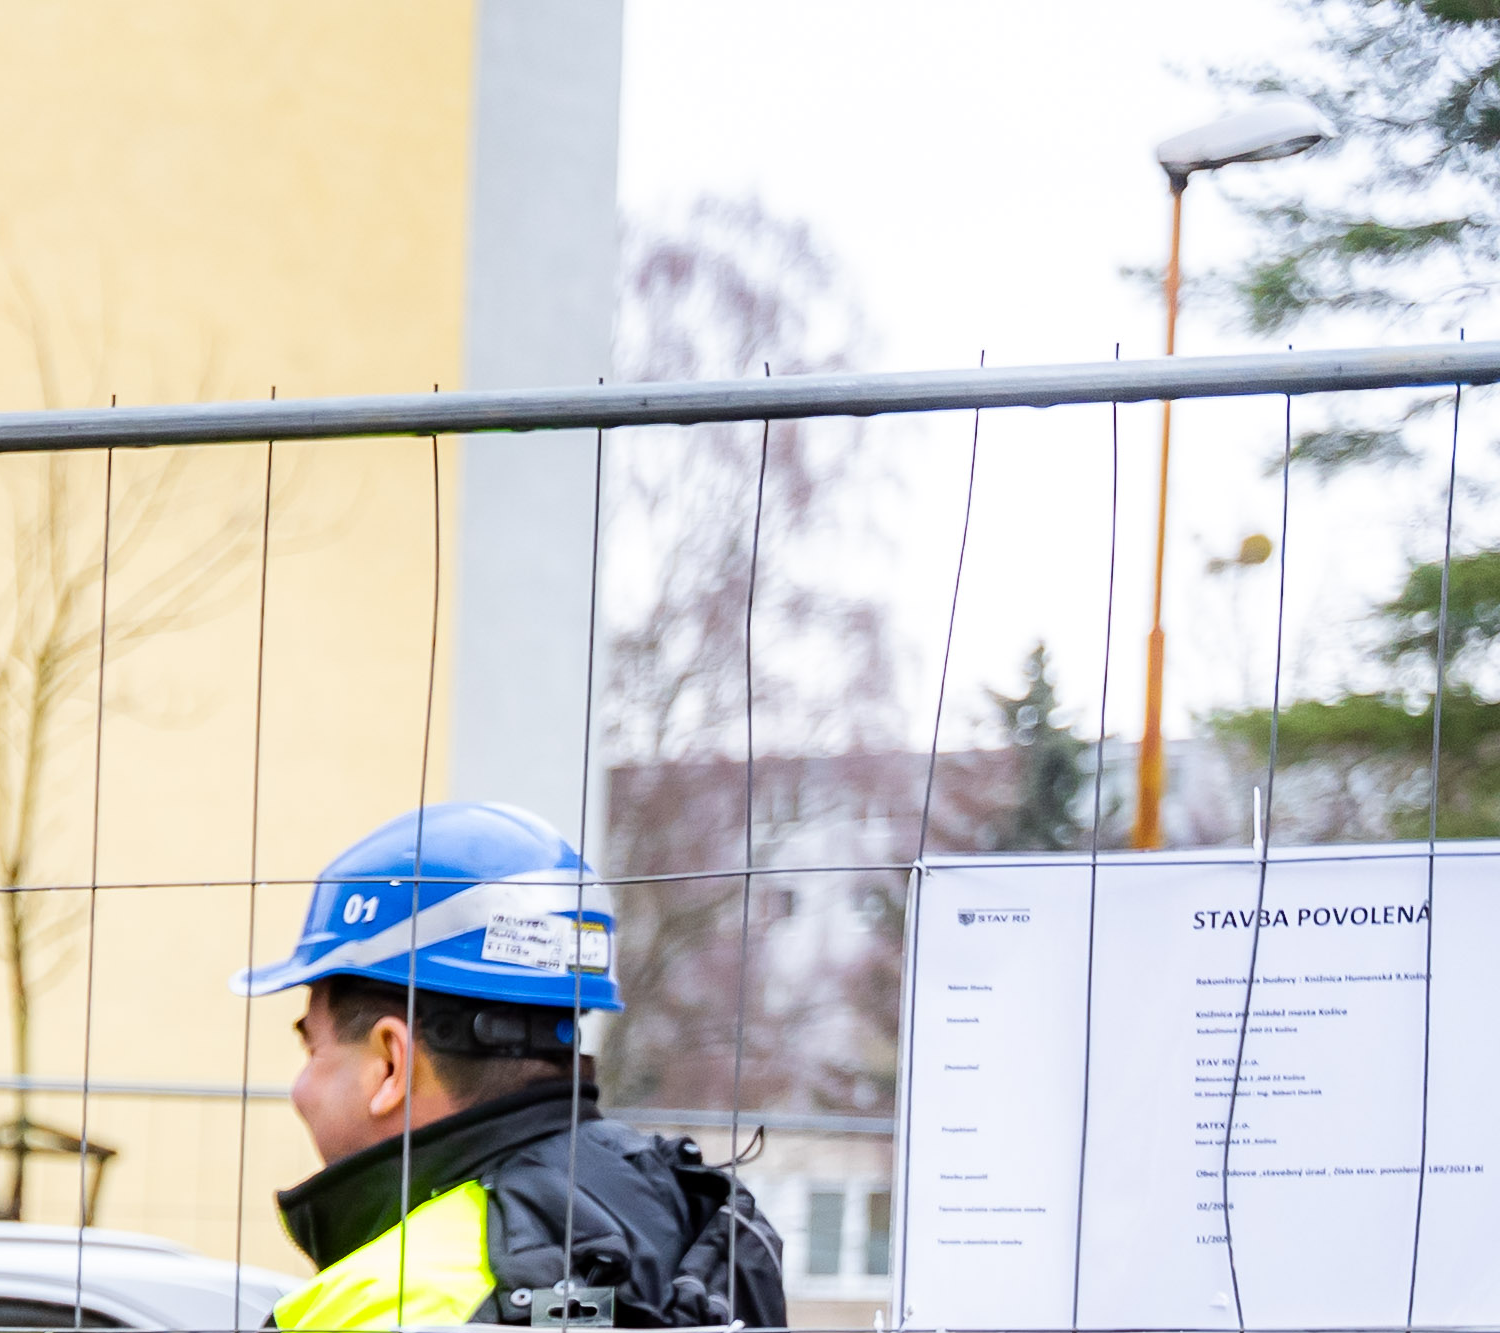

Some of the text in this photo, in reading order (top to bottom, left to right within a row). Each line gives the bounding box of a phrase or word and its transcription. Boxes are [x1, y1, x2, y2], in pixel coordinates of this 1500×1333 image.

[343, 893, 379, 925] 01
[1193, 900, 1430, 930] STAVBA POVOLENÁ
